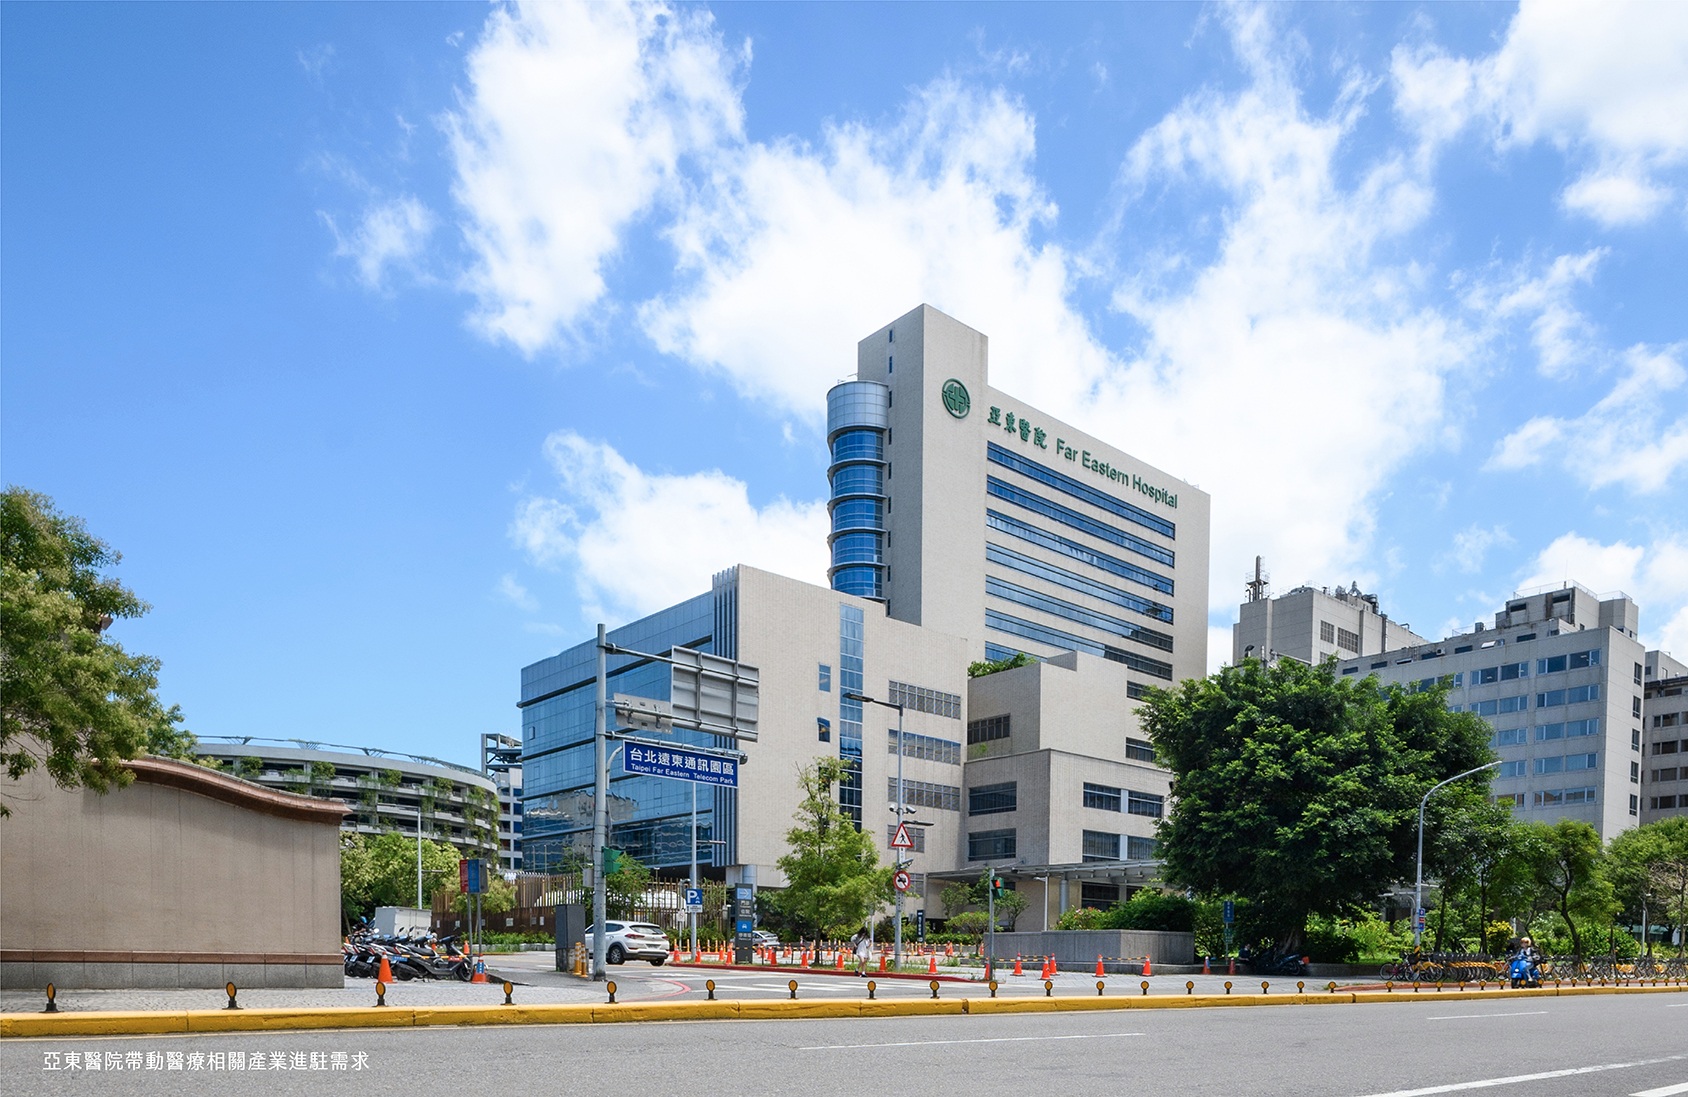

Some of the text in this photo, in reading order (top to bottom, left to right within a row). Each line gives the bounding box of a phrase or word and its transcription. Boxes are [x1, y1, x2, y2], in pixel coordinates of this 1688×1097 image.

[987, 405, 1178, 509] 亞東醫院 Far Eastern Hospital
[630, 747, 734, 775] 台北遠東通訊園區
[630, 763, 734, 785] Taipei Far Eastern Telecom Park
[687, 890, 698, 904] P
